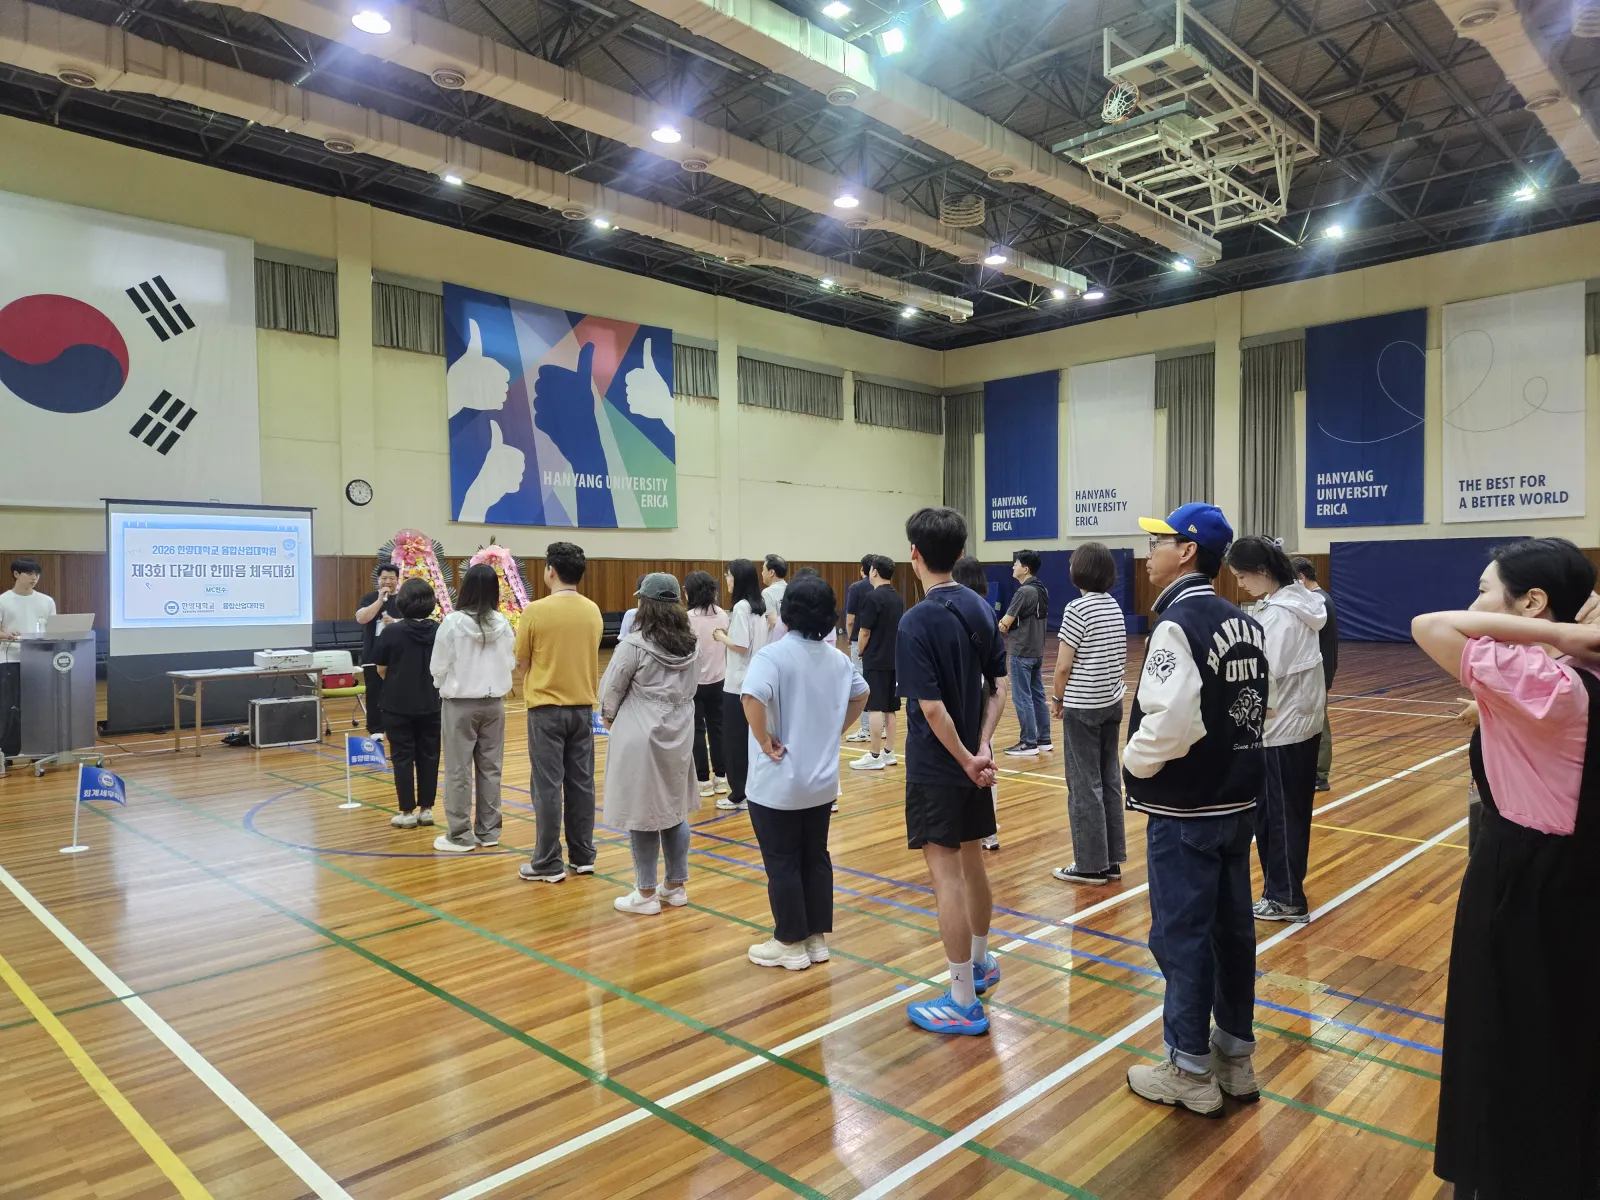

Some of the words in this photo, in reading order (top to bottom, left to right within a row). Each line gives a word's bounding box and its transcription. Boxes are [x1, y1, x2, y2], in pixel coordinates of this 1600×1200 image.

[543, 471, 602, 489] HANYANG
[605, 475, 668, 492] UNIVERSITY
[1317, 469, 1374, 485] HANYANG
[1458, 479, 1482, 492] THE
[1486, 477, 1515, 491] BEST
[1520, 474, 1546, 488] FOR
[1075, 488, 1117, 500] HANYANG
[1317, 485, 1388, 501] UNIVERSITY
[641, 494, 668, 508] ERICA
[992, 495, 1028, 507] HANYANG
[1459, 497, 1467, 509] A
[1471, 494, 1515, 509] BETTER
[1519, 491, 1569, 506] WORLD
[992, 507, 1037, 519] UNIVERSITY
[1075, 501, 1128, 513] UNIVERSITY
[1316, 503, 1348, 516] ERICA
[992, 521, 1012, 532] ERICA
[1075, 516, 1098, 526] ERICA
[152, 545, 175, 555] 2026
[177, 545, 219, 556] 한양대학교
[221, 546, 277, 556] 융합산업대학원
[131, 563, 166, 578] 제3회
[170, 564, 207, 578] 다같이
[210, 564, 246, 578] 한마음
[249, 564, 295, 579] 체육대회
[181, 602, 215, 610] 한양대학교
[222, 602, 265, 610] 융합산업대학원
[1226, 657, 1265, 682] UNIV.
[1232, 743, 1249, 751] Since
